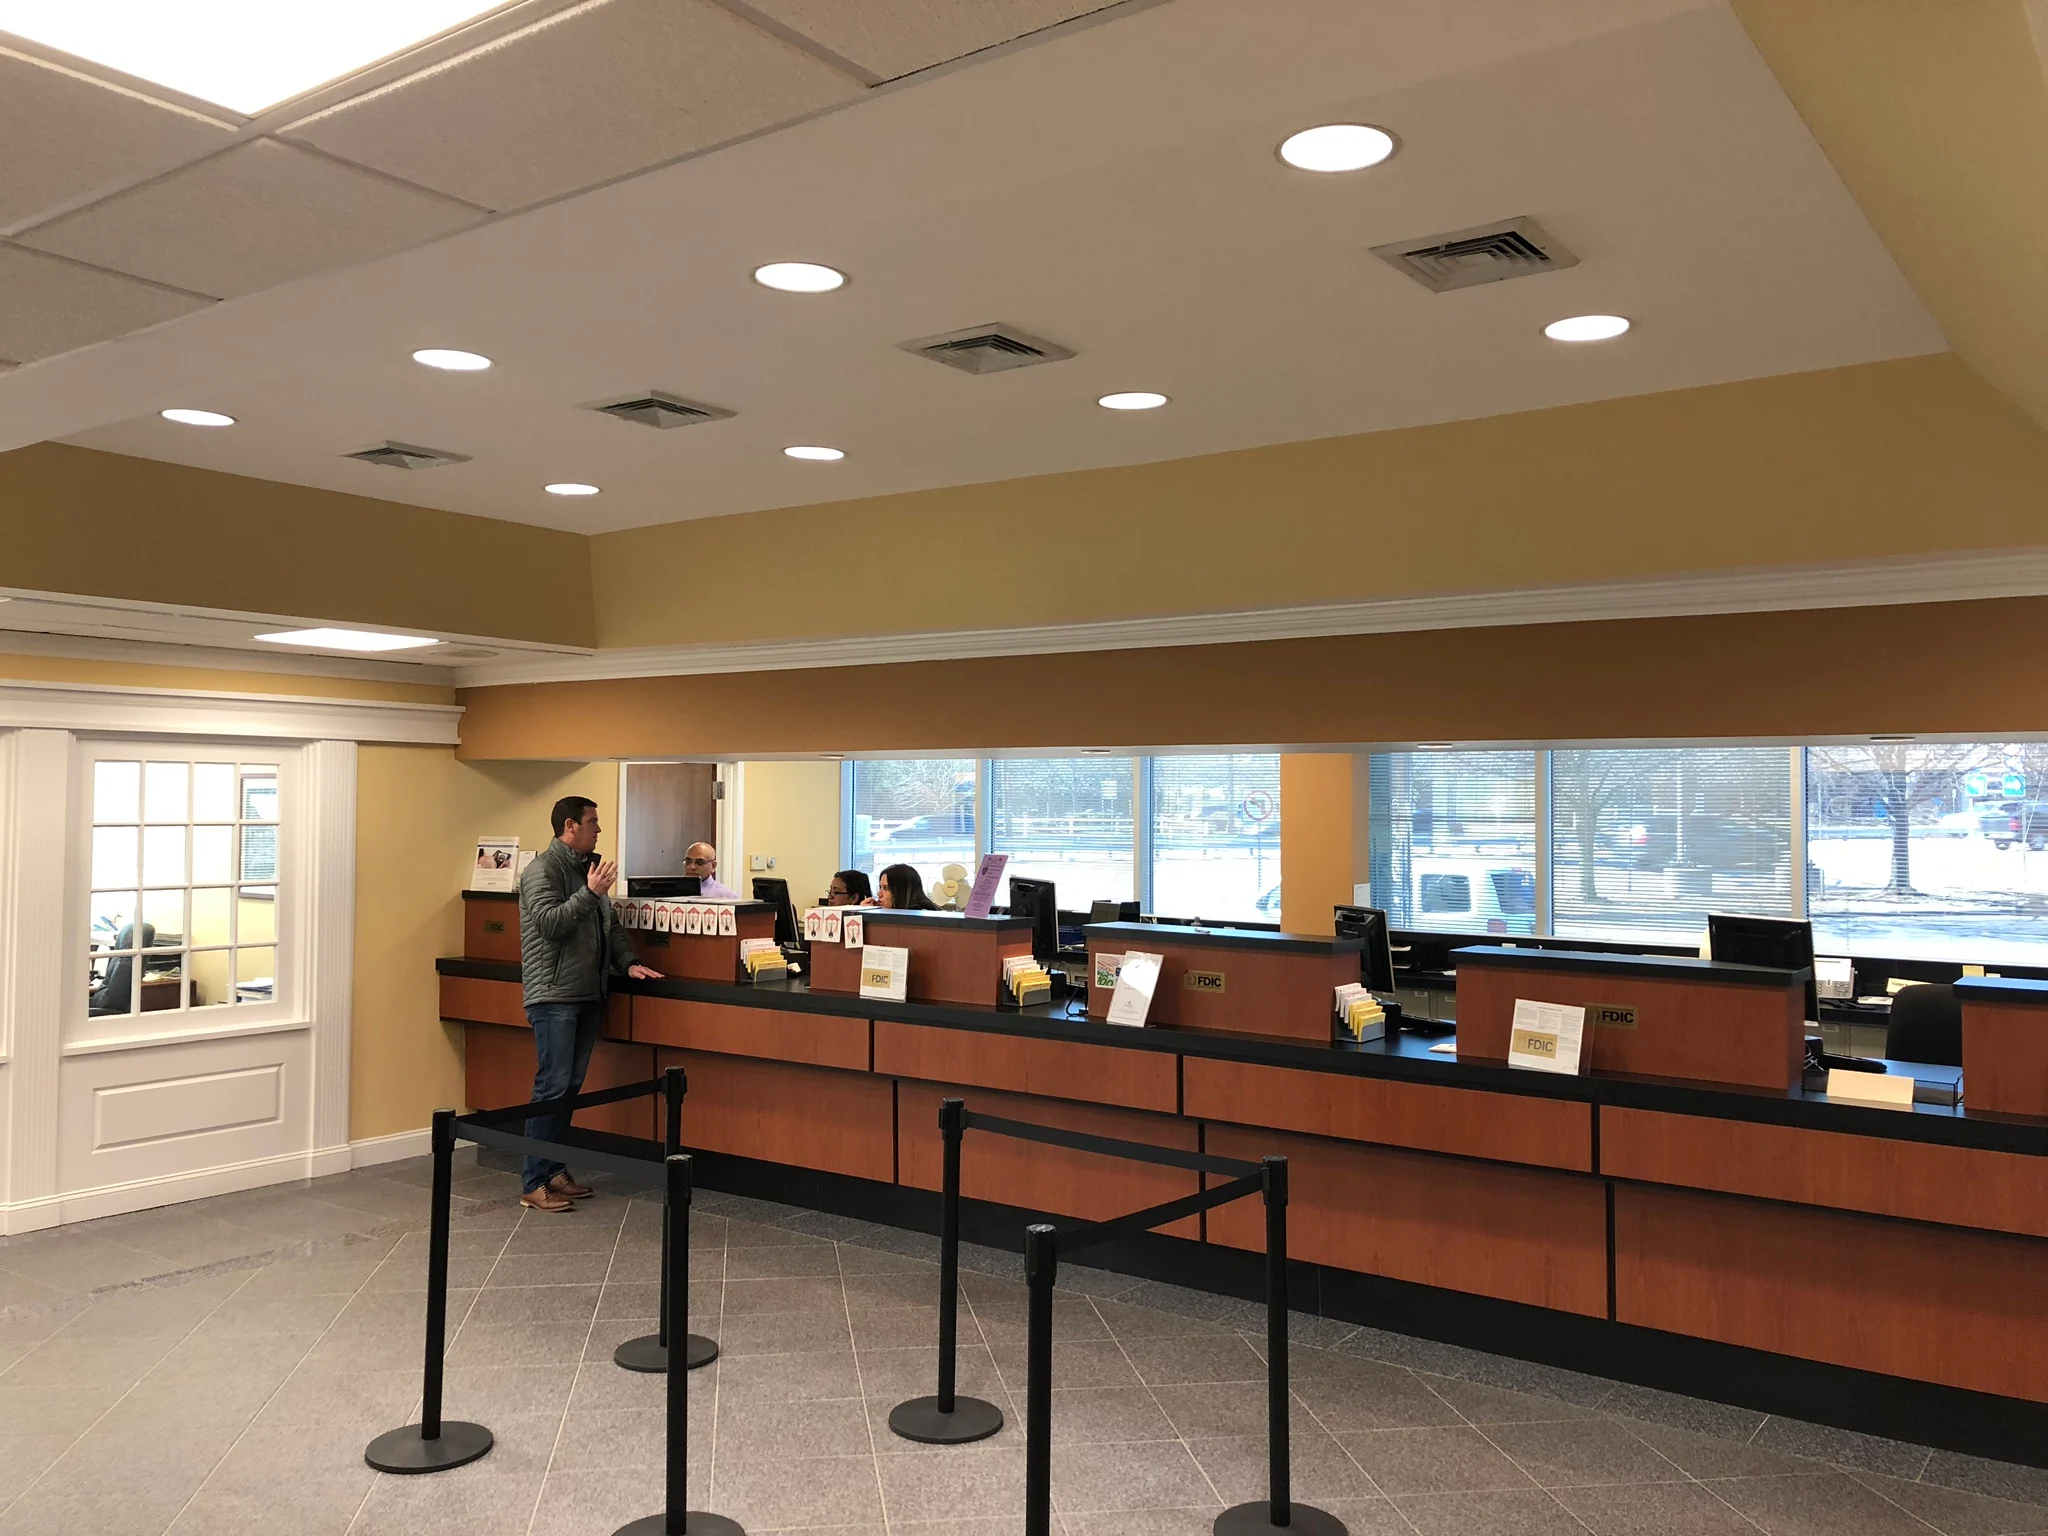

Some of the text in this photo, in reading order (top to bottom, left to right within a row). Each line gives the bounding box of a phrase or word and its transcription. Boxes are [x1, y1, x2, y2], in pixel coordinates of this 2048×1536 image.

[871, 974, 889, 984] FDIC
[1198, 976, 1222, 987] FDIC
[1602, 1010, 1634, 1023] FDIC
[1527, 1038, 1553, 1052] FDIC
